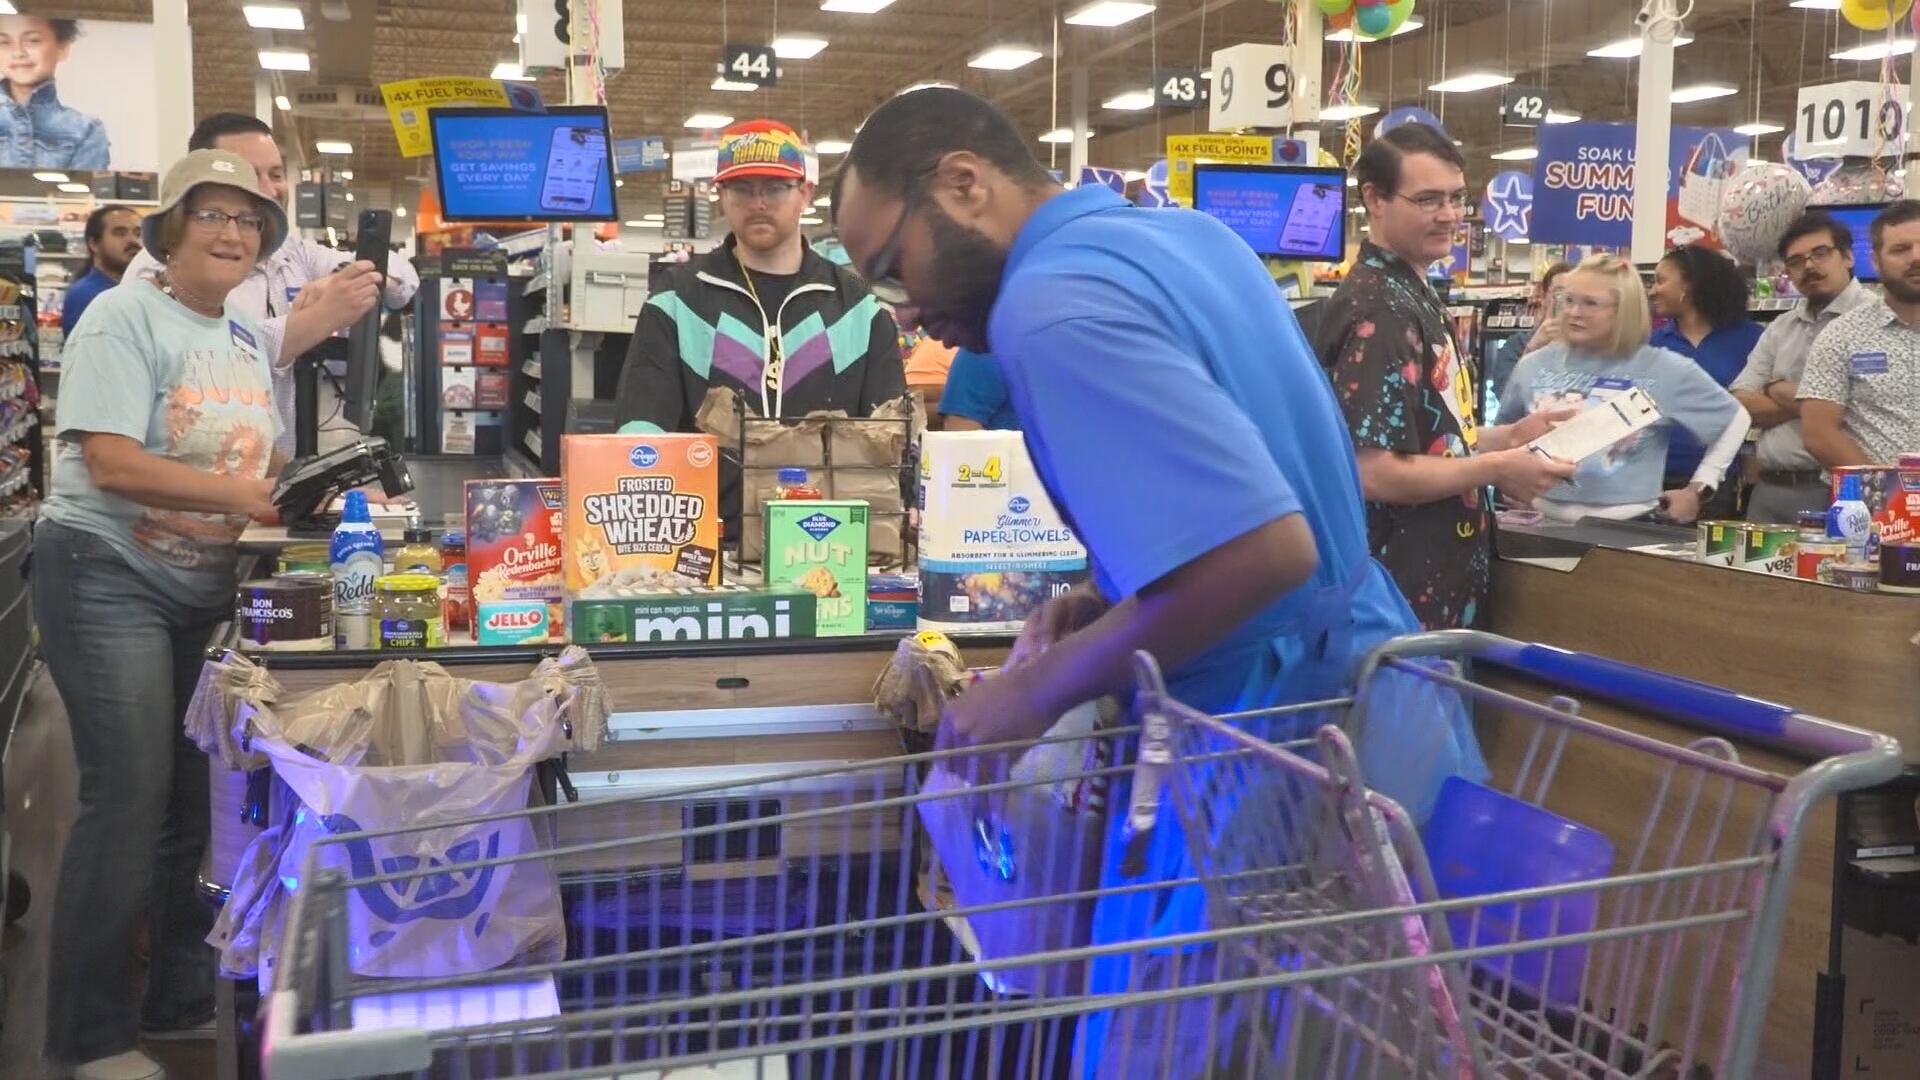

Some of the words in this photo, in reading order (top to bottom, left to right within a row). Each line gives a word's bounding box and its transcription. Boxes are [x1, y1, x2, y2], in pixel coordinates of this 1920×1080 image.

[732, 52, 770, 78] 44
[393, 90, 413, 101] 4X
[415, 87, 452, 99] FUEL
[456, 86, 504, 100] POINTS
[1162, 77, 1196, 101] 43
[1220, 66, 1234, 112] 9
[1265, 63, 1295, 109] 9
[1513, 96, 1543, 118] 42
[1802, 98, 1846, 143] 10
[1174, 144, 1189, 153] 4X
[1192, 144, 1222, 154] FUEL
[1225, 145, 1268, 156] POINTS
[1578, 146, 1623, 161] SOAK
[450, 163, 475, 173] GET
[480, 163, 537, 173] SAVINGS
[456, 174, 500, 183] EVERY
[1230, 209, 1280, 219] SAVINGS
[630, 448, 657, 465] Kroger
[620, 478, 672, 492] FROSTED
[585, 494, 703, 524] SHREDDED
[604, 517, 695, 545] WHEAT
[996, 515, 1041, 530] Glimmer
[964, 530, 1010, 544] PAPER
[1011, 529, 1071, 543] TOWELS
[503, 542, 557, 566] Orville
[784, 541, 852, 568] NUT
[252, 599, 273, 608] DON
[635, 600, 790, 642] mini
